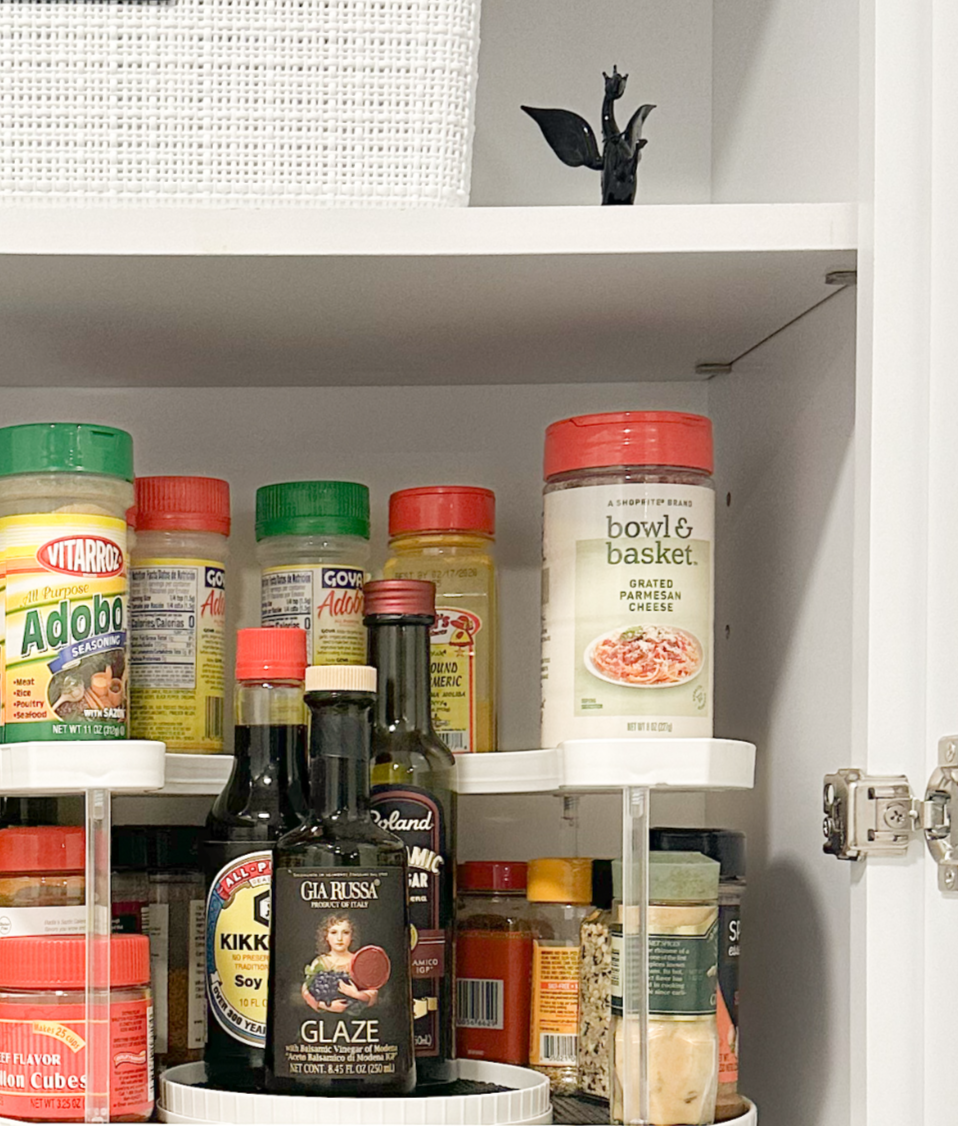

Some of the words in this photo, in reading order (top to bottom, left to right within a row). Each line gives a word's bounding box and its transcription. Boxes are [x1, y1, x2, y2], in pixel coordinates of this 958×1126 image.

[667, 499, 693, 508] BRAND
[606, 514, 671, 539] bowl
[674, 517, 694, 539] &
[47, 538, 119, 573] VITARROZ
[605, 540, 693, 566] basket
[629, 579, 674, 589] GRATED
[43, 583, 90, 601] Purpose
[619, 590, 682, 601] PARMESAN
[628, 602, 674, 612] CHEESE
[21, 594, 123, 658] Adobo
[72, 635, 121, 658] SEASONING
[16, 678, 35, 686] Meat
[16, 689, 32, 697] Rice
[16, 700, 45, 709] Poultry
[16, 711, 47, 719] Seafood
[53, 724, 67, 734] NET
[69, 724, 81, 734] WT
[301, 880, 328, 901] GIA
[330, 880, 378, 901] RUSSA
[221, 933, 270, 951] KIKK
[412, 958, 439, 967] AMICO
[234, 975, 263, 990] Soy
[213, 985, 229, 1011] OVER
[227, 1009, 244, 1026] 300
[300, 1019, 380, 1044] GLAZE
[55, 1026, 67, 1039] 25
[65, 1035, 80, 1051] cups
[300, 1044, 332, 1053] Balsamic
[333, 1045, 363, 1054] Vinegar
[364, 1045, 373, 1053] of
[13, 1052, 61, 1066] FLAVOR
[307, 1053, 346, 1062] Balsamico
[356, 1053, 384, 1061] Modena
[289, 1063, 303, 1074] NET
[303, 1063, 327, 1074] CONT.
[328, 1063, 344, 1074] 8.45
[345, 1063, 355, 1074] FL
[355, 1063, 367, 1074] OZ
[30, 1071, 88, 1090] Cubes
[30, 1098, 44, 1109] NET
[44, 1098, 56, 1109] WT
